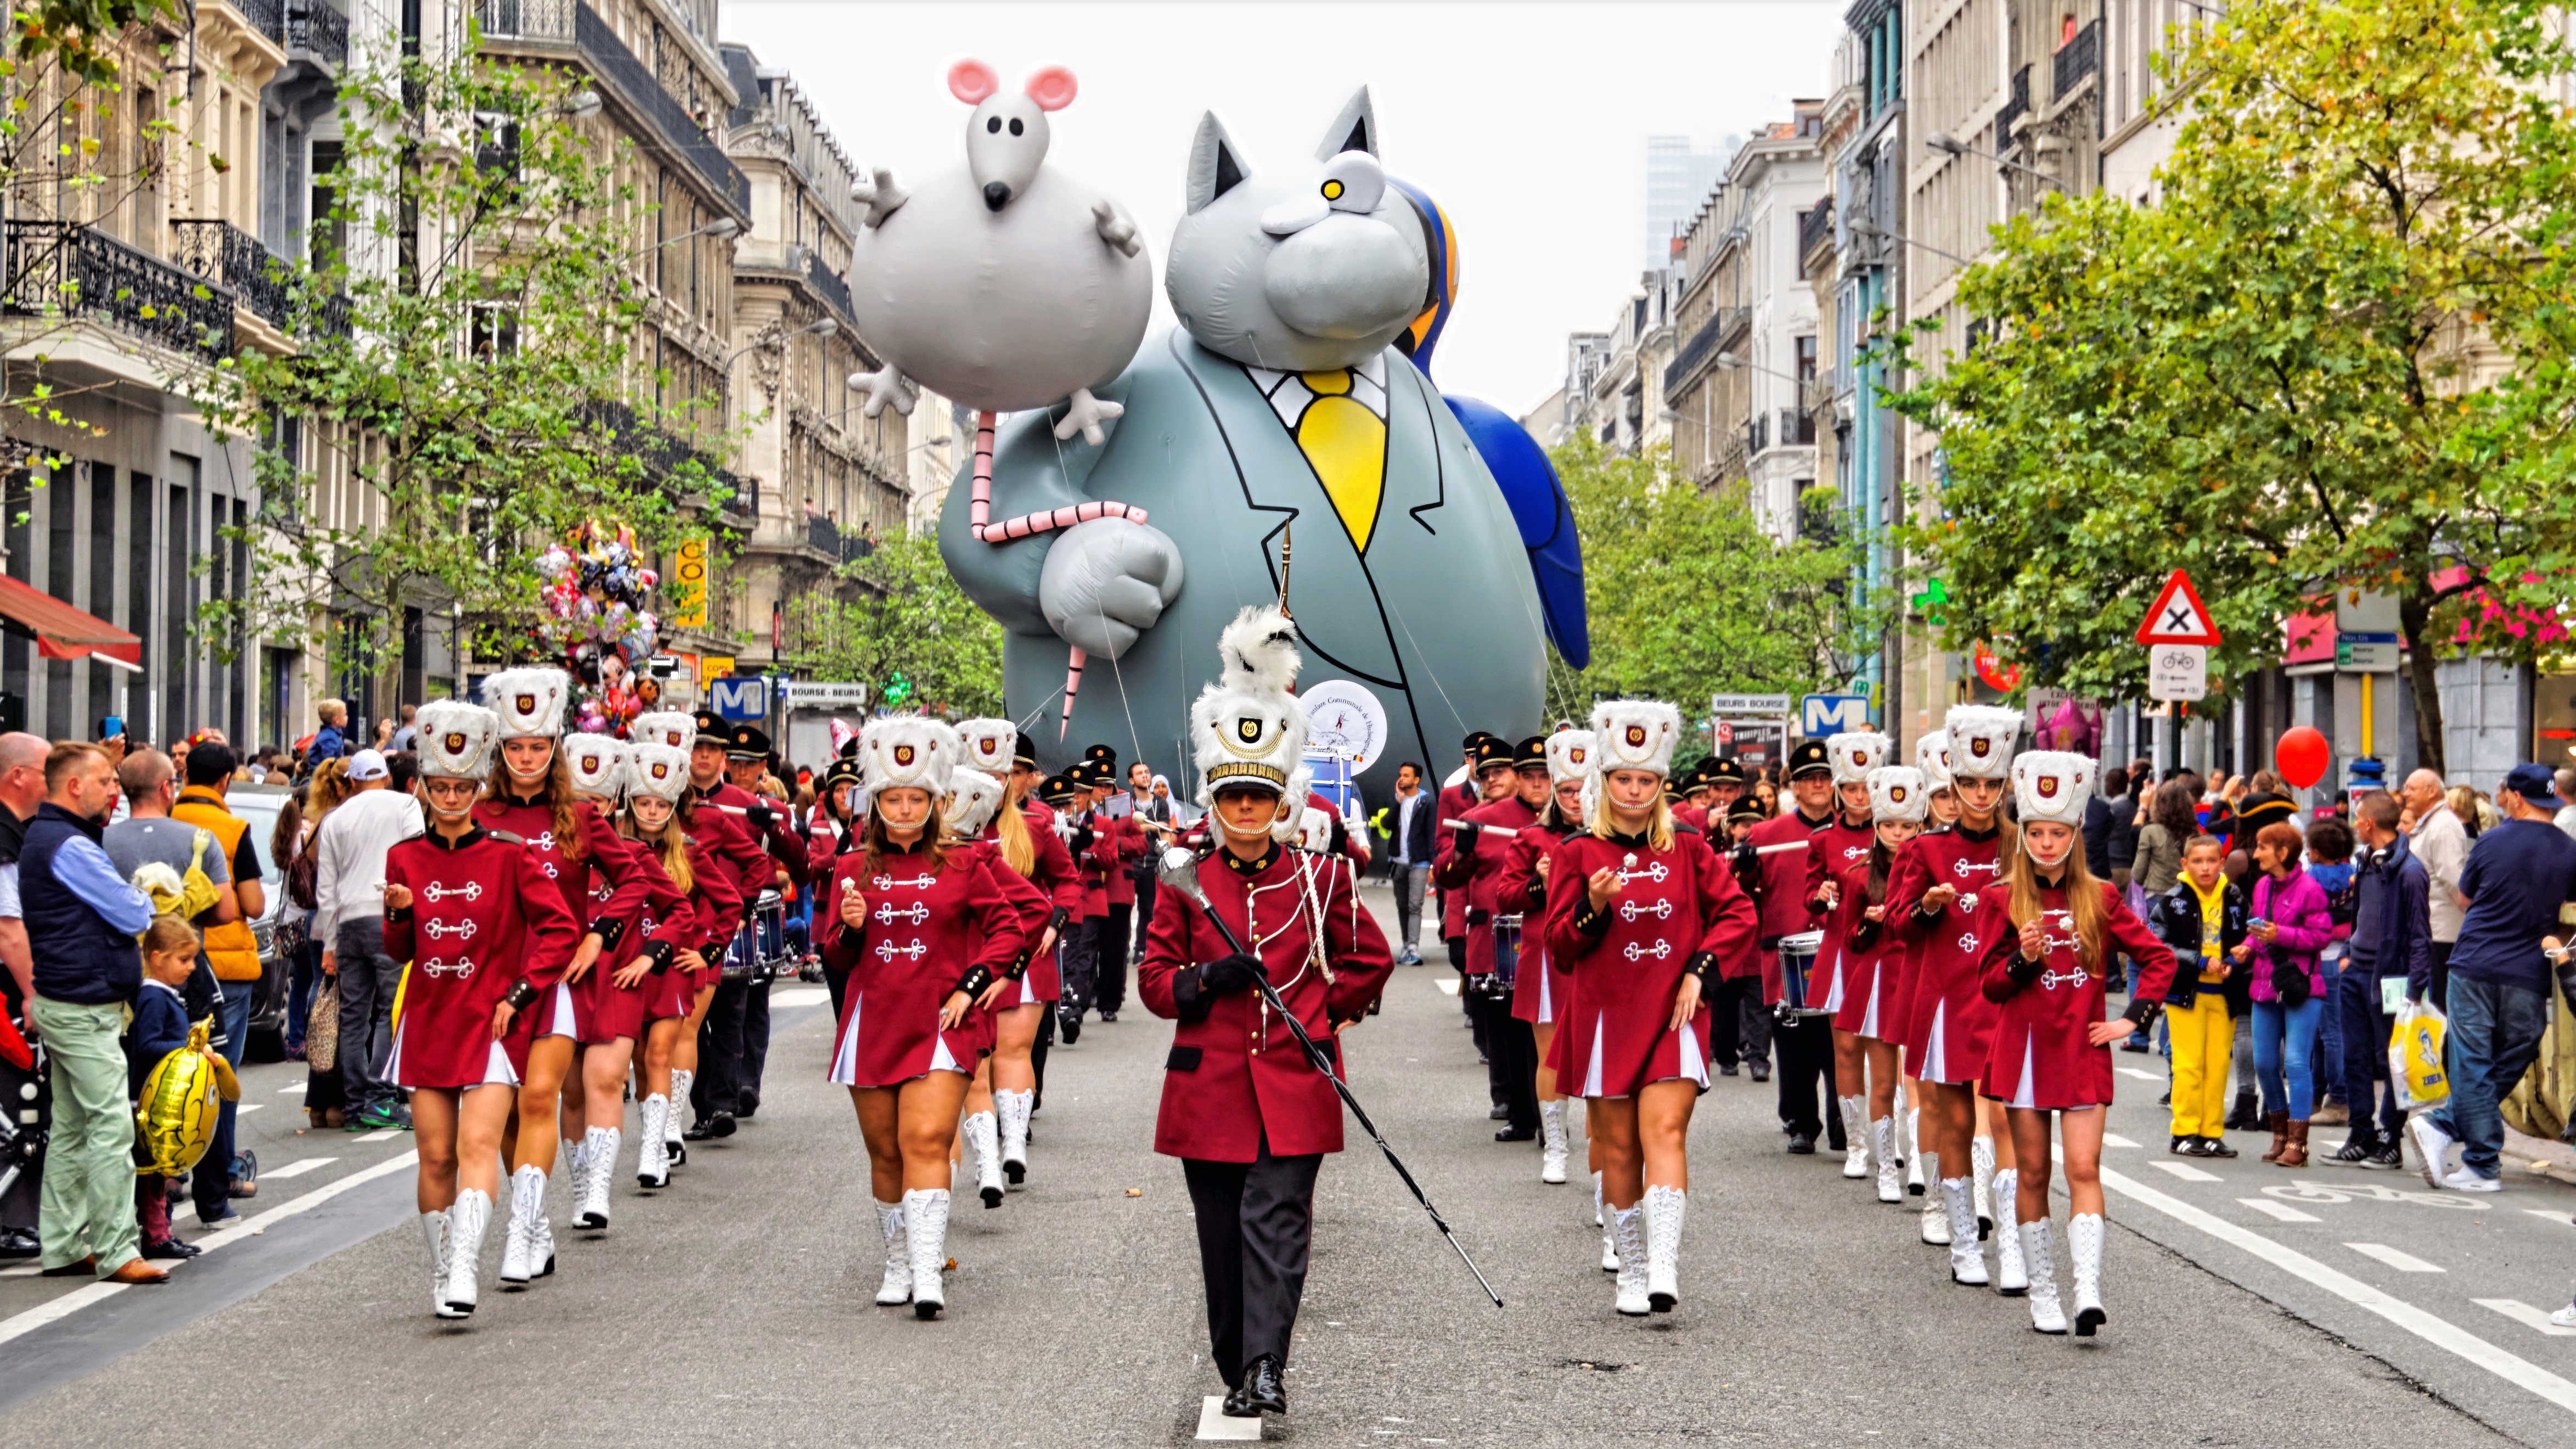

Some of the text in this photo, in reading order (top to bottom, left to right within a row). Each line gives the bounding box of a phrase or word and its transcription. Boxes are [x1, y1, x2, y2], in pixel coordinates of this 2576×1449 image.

[792, 688, 826, 697] BOURSE
[833, 688, 860, 697] BEURS
[1717, 699, 1785, 708] BEURS BOURSE
